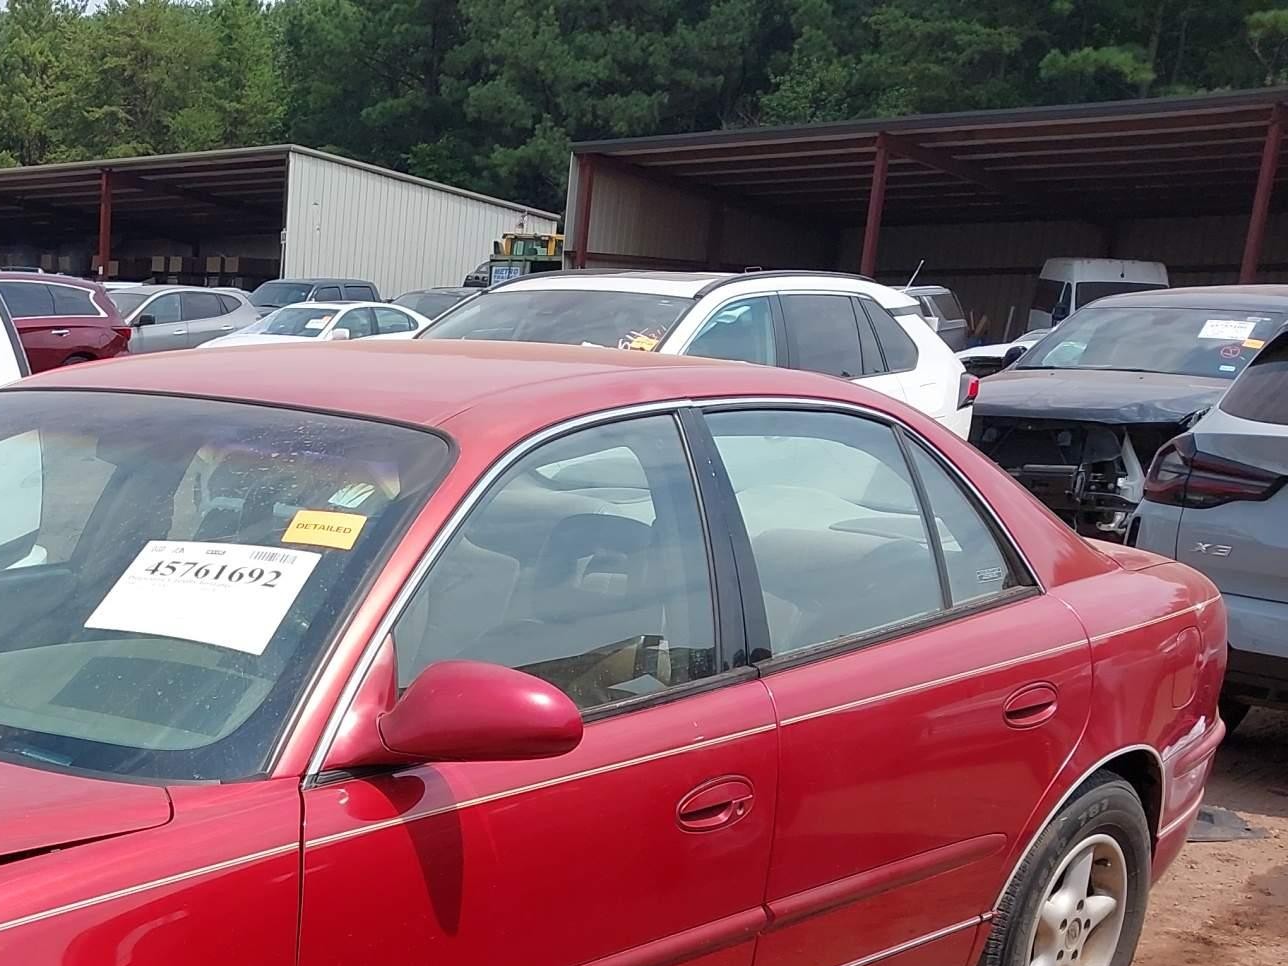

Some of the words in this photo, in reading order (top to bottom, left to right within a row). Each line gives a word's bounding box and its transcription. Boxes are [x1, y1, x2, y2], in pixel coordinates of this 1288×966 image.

[296, 522, 352, 534] DETAILED
[1196, 542, 1232, 558] X3
[145, 560, 282, 588] 45761692
